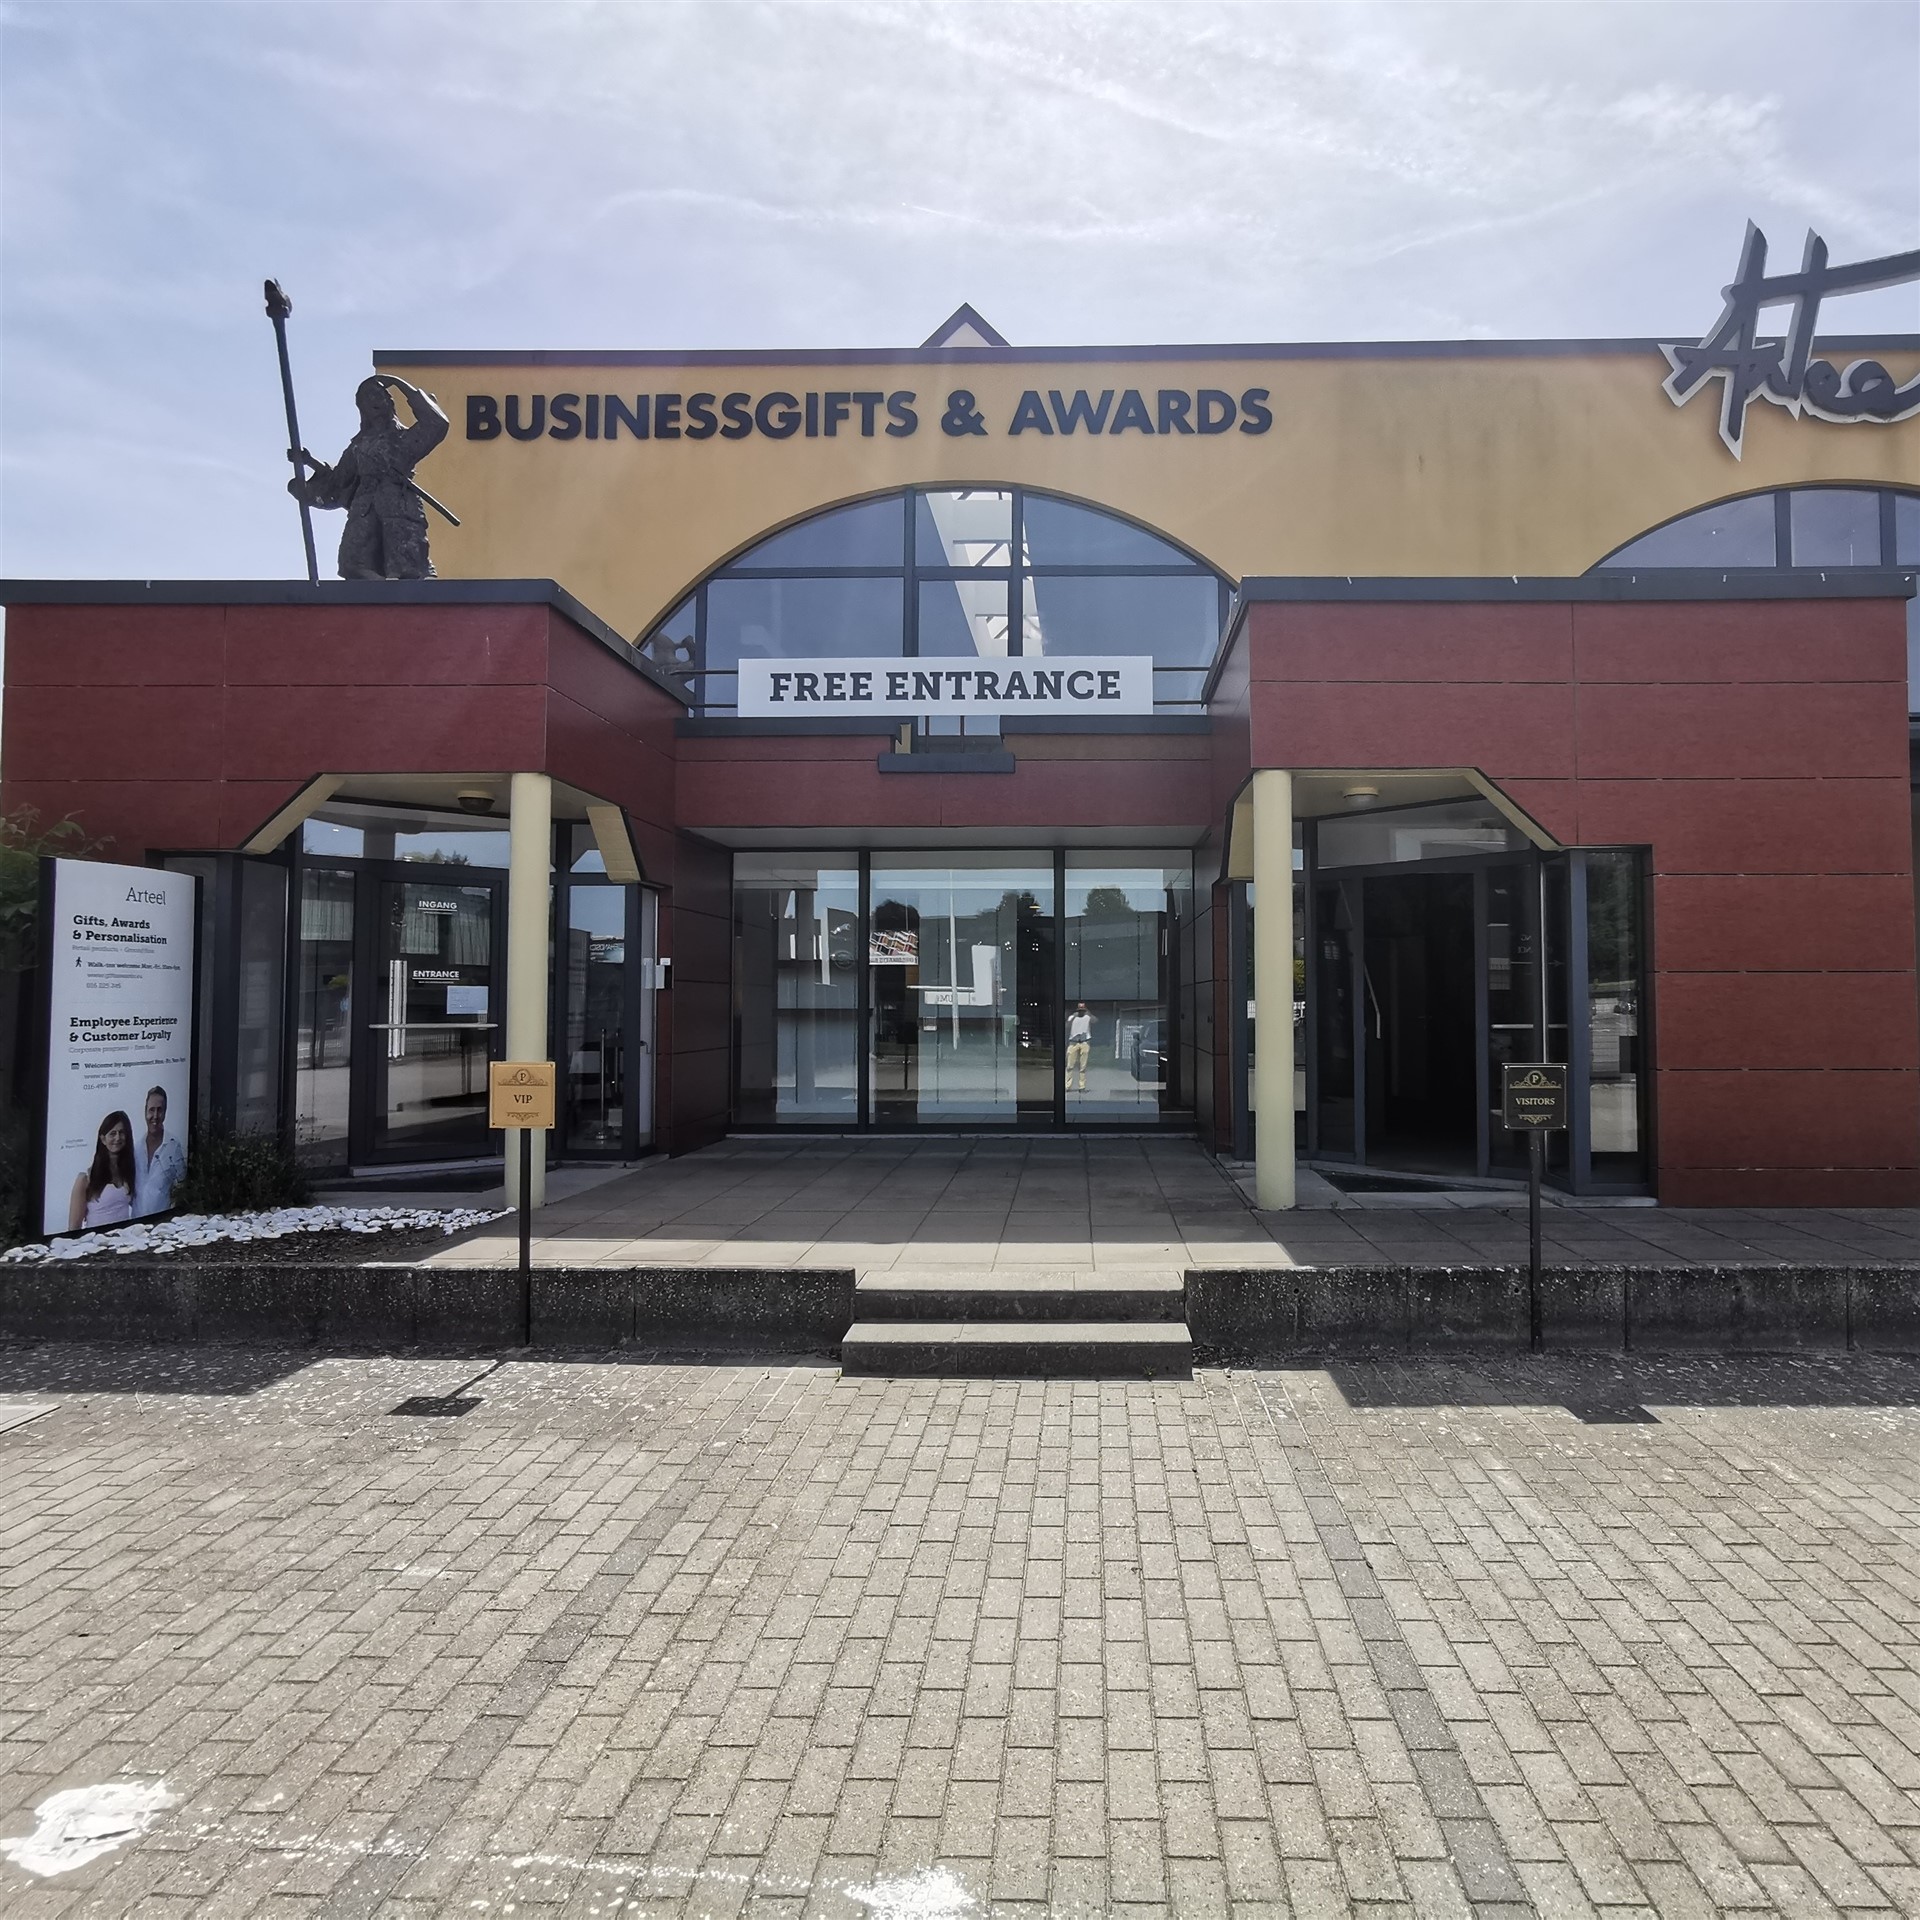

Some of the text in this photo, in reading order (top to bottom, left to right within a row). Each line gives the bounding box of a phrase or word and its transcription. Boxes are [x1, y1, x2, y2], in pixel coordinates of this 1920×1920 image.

[466, 387, 1273, 441] BUSINESSGIFTS & AWARDS
[769, 670, 1122, 702] FREE ENTRANCE
[126, 887, 166, 905] Arteel
[419, 900, 457, 910] INGANG
[73, 915, 151, 931] Gifts, Awards
[72, 929, 168, 945] & Personalisation
[413, 970, 459, 978] ENTRANCE
[70, 1016, 178, 1029] Employee Experience
[69, 1029, 171, 1042] & Customer Loyalty
[520, 1072, 527, 1081] P
[513, 1094, 533, 1105] VIP
